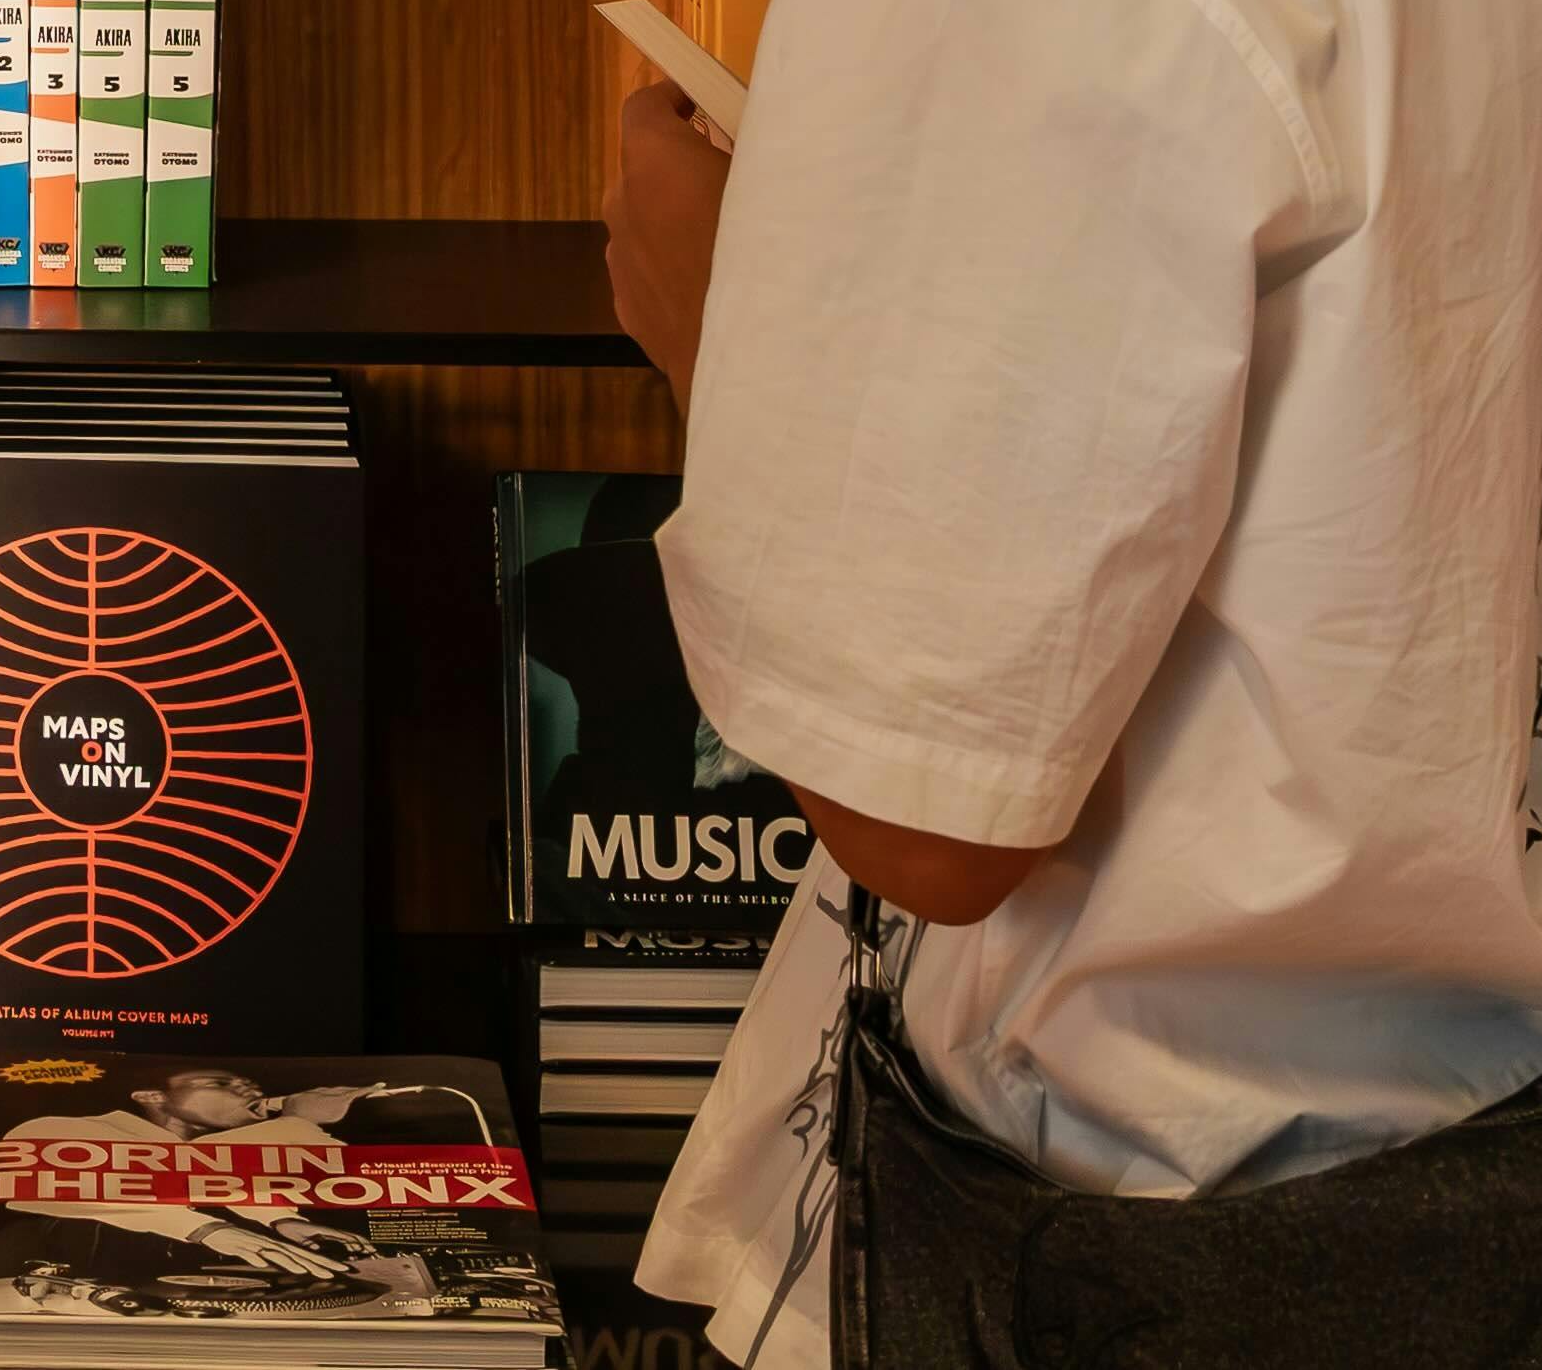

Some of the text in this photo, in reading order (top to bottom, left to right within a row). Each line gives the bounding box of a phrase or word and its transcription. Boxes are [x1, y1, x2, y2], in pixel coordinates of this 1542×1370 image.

[42, 715, 126, 741] MAPS
[80, 741, 127, 765] ON
[59, 764, 152, 789] VINYL
[262, 1146, 346, 1175] IN
[187, 1176, 527, 1207] BRONX
